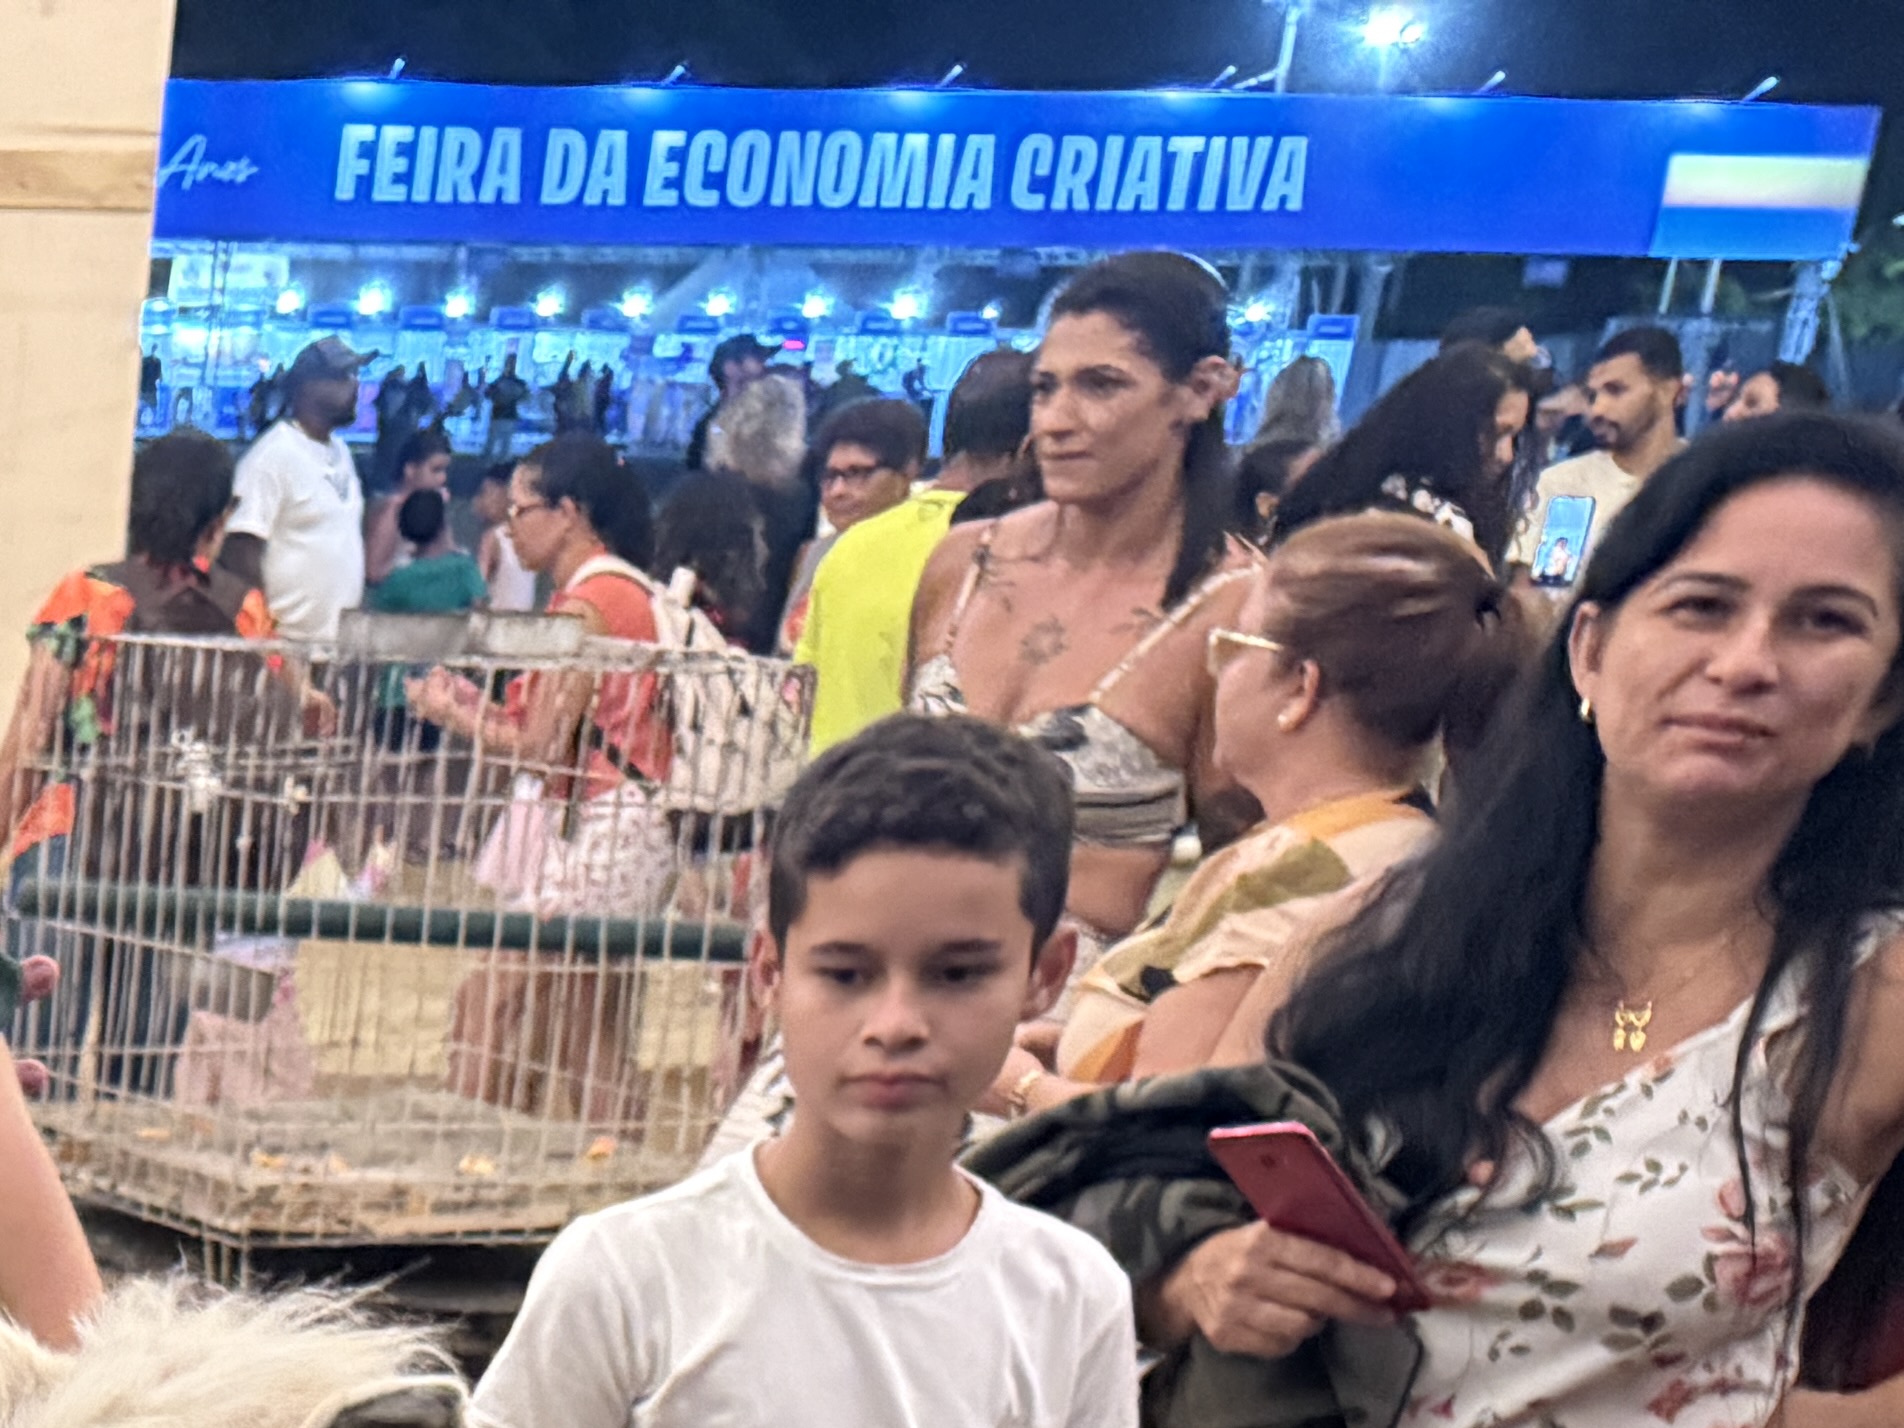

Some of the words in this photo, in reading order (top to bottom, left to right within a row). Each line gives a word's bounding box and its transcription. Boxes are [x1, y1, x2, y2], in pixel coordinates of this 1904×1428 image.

[334, 123, 523, 203] FEIRA
[539, 127, 627, 206] DA
[642, 130, 995, 209] ECONOMIA
[1011, 133, 1307, 211] CRIATIVA
